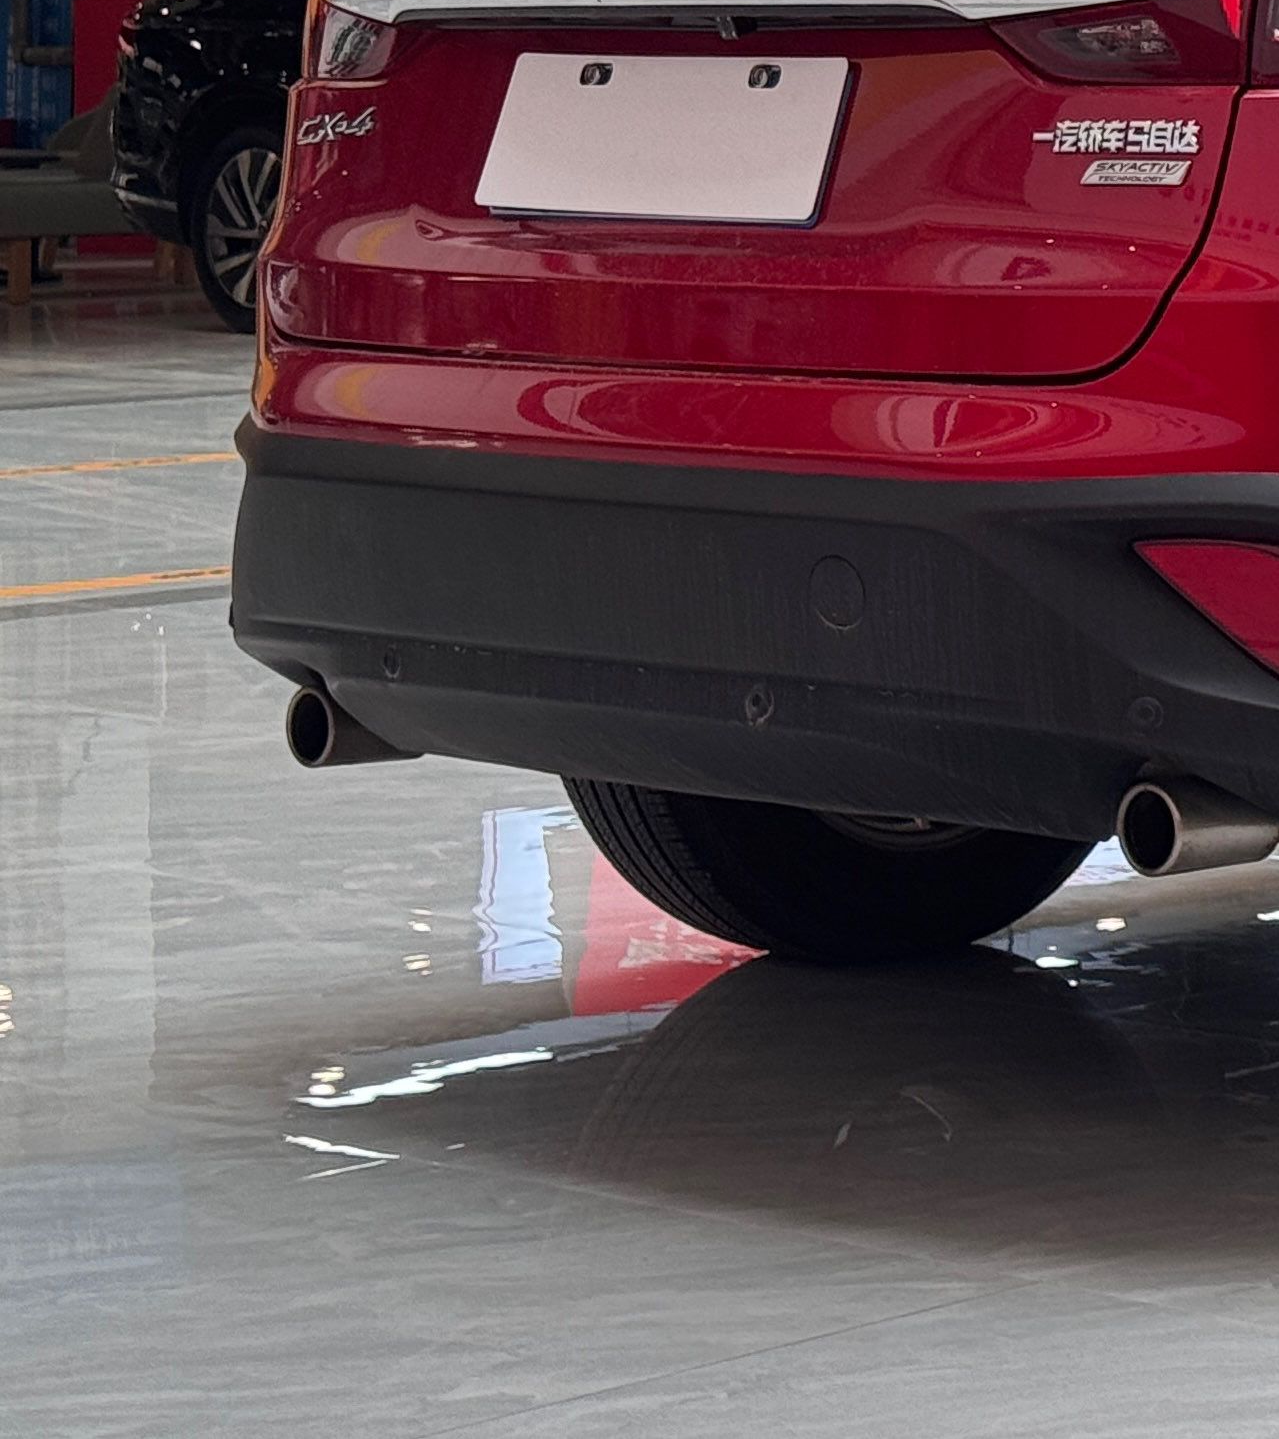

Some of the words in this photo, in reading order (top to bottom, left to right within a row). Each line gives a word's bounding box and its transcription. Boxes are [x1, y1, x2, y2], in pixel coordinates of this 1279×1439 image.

[297, 106, 377, 146] CX-4
[1094, 162, 1178, 173] SKYACTIV
[1098, 175, 1167, 183] TECHNOLOGY
